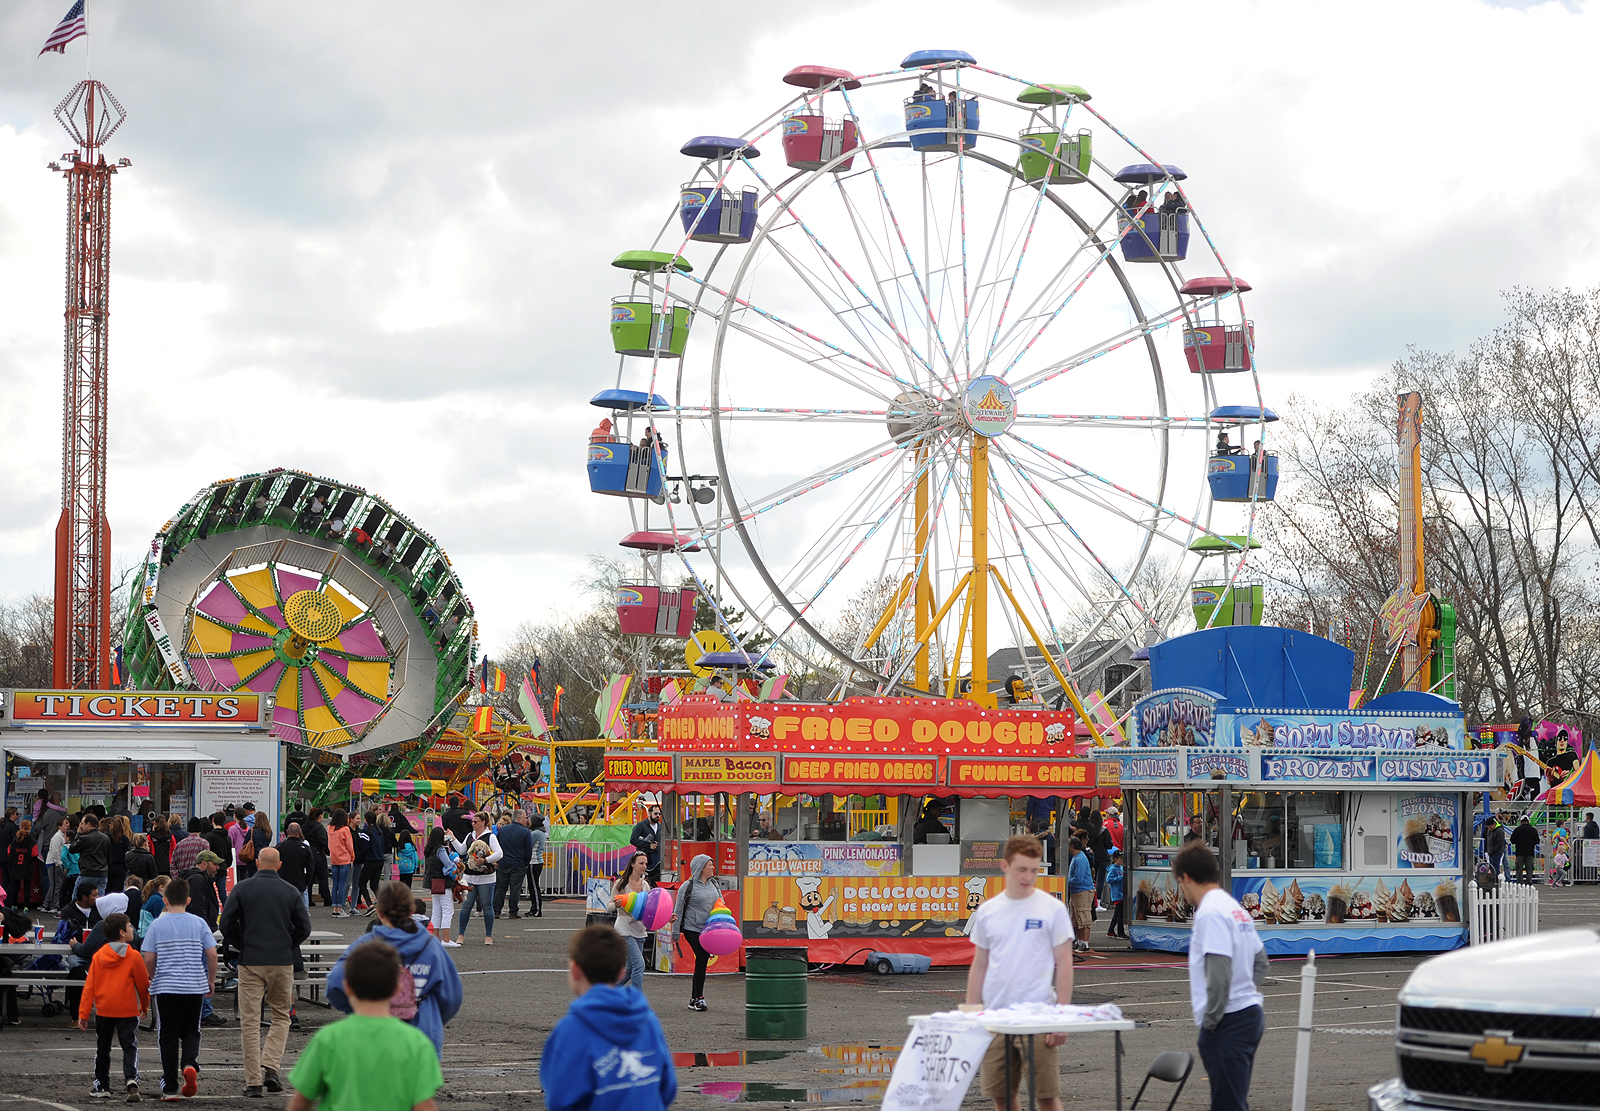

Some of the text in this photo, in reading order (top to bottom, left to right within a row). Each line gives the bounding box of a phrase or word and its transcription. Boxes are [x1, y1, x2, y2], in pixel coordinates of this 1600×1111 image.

[974, 414, 1008, 422] Amusement
[36, 695, 240, 719] TICKETS
[1142, 696, 1211, 736] SOFT SERVE
[663, 716, 734, 740] FRIED DOUGH
[773, 716, 1044, 744] FRIED DOUGH
[1273, 719, 1417, 750] SOFT SERVE
[608, 759, 669, 777] FRIED DOUGH
[685, 757, 773, 771] MAPLE Bacon
[789, 761, 933, 780] DEEP FRIED OREOS
[1131, 757, 1177, 778] SUNDAES
[1190, 761, 1249, 778] FLOATS
[1264, 758, 1487, 780] FROZEN CUSTARD
[684, 771, 773, 780] FRIED DOUGH
[959, 764, 1086, 783] FUNNEL CAKE
[1401, 802, 1455, 817] FLOATS
[17, 854, 24, 865] 9
[823, 847, 898, 860] PINK LEMONADE!
[1400, 849, 1455, 864] SUNDAES
[748, 860, 787, 872] BOTTLED
[788, 860, 822, 872] WATER!
[843, 886, 960, 899] DELICIOUS
[843, 902, 960, 912] IS HOW WE ROLL!
